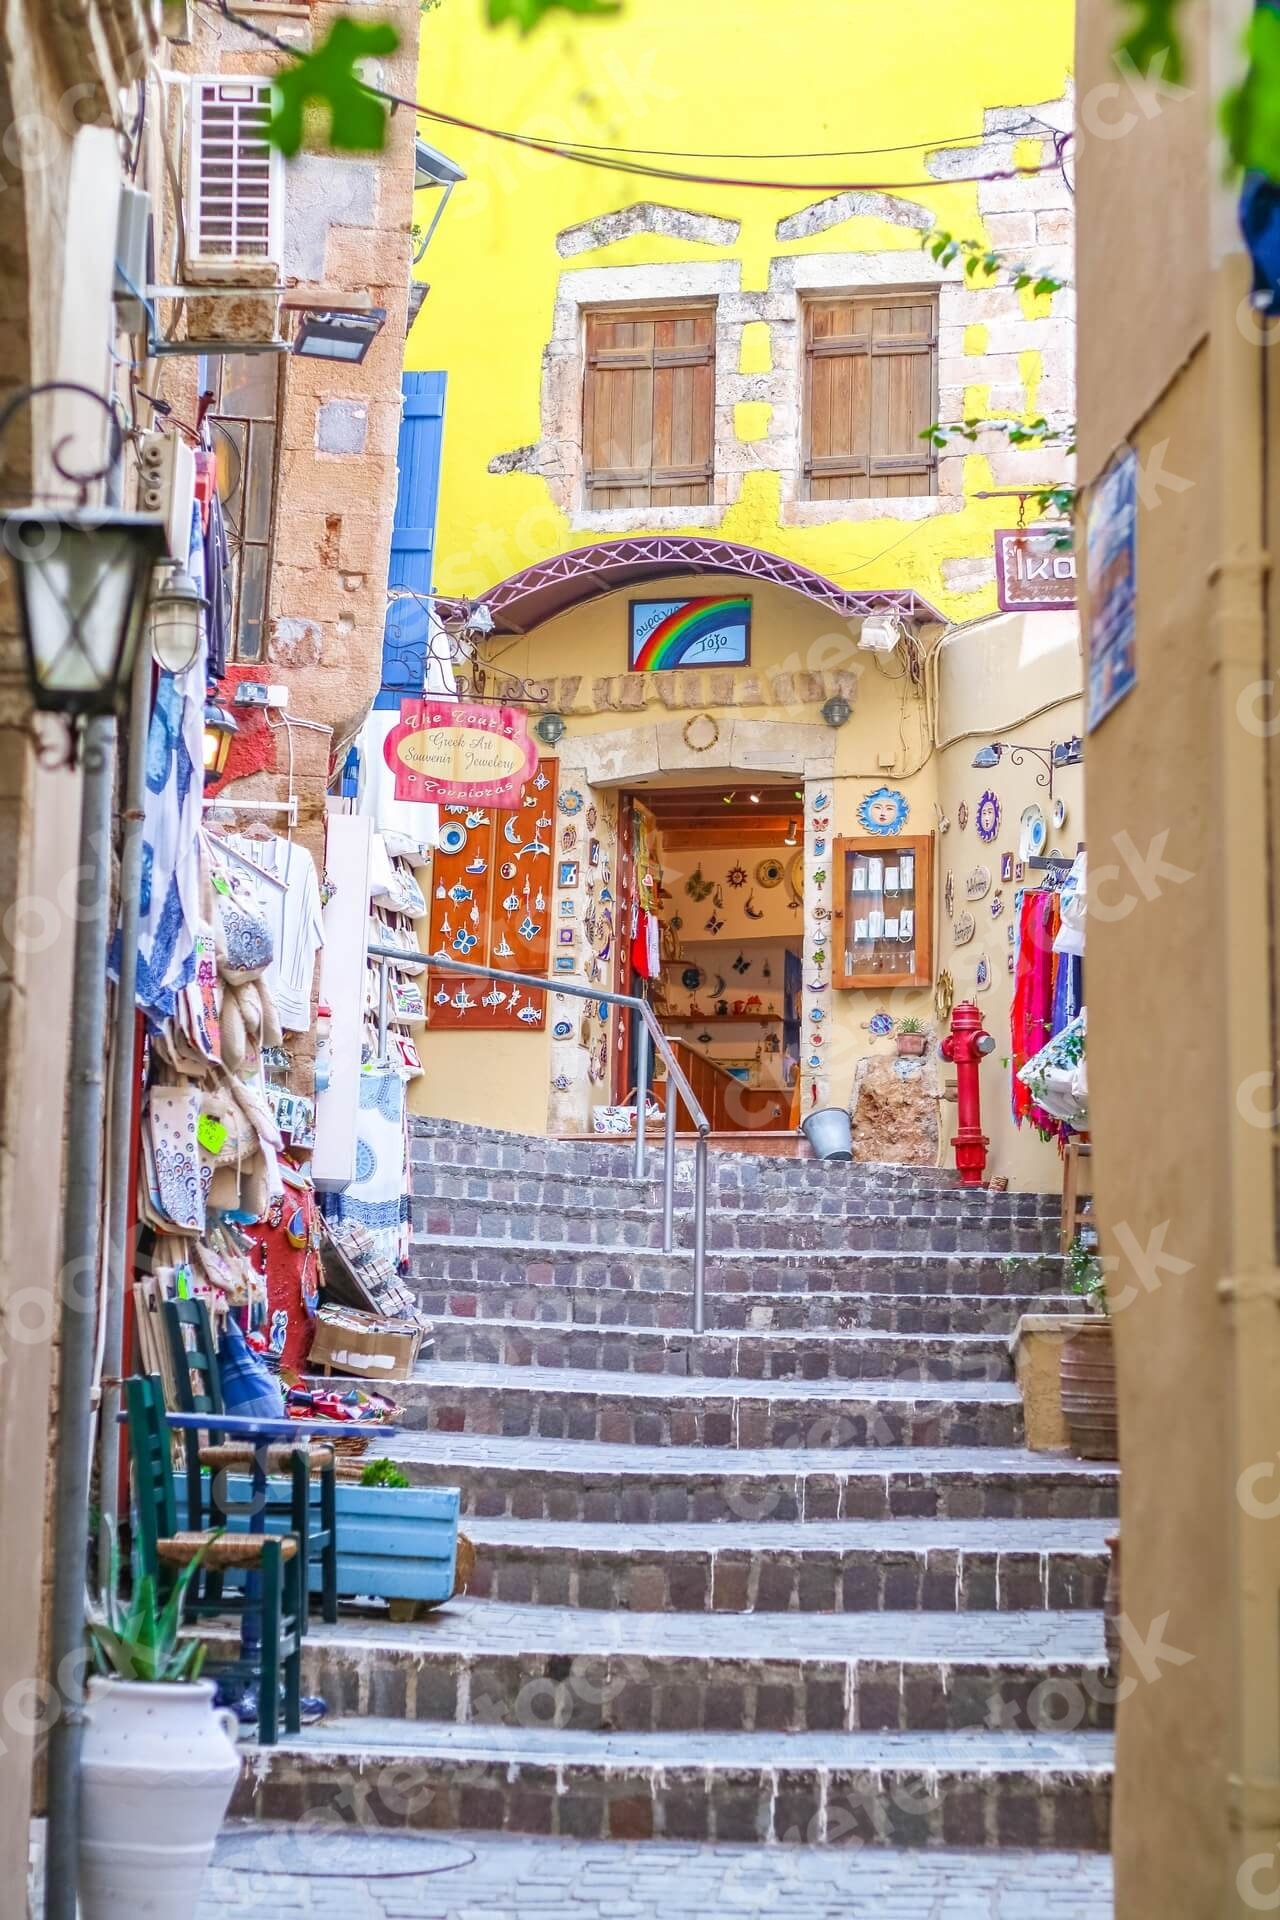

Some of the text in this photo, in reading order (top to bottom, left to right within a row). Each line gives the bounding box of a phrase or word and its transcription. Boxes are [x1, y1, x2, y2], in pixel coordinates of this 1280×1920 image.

[404, 711, 520, 739] The Tourist
[429, 732, 494, 751] Greek Art
[404, 746, 514, 774] Souvenir Jewelery
